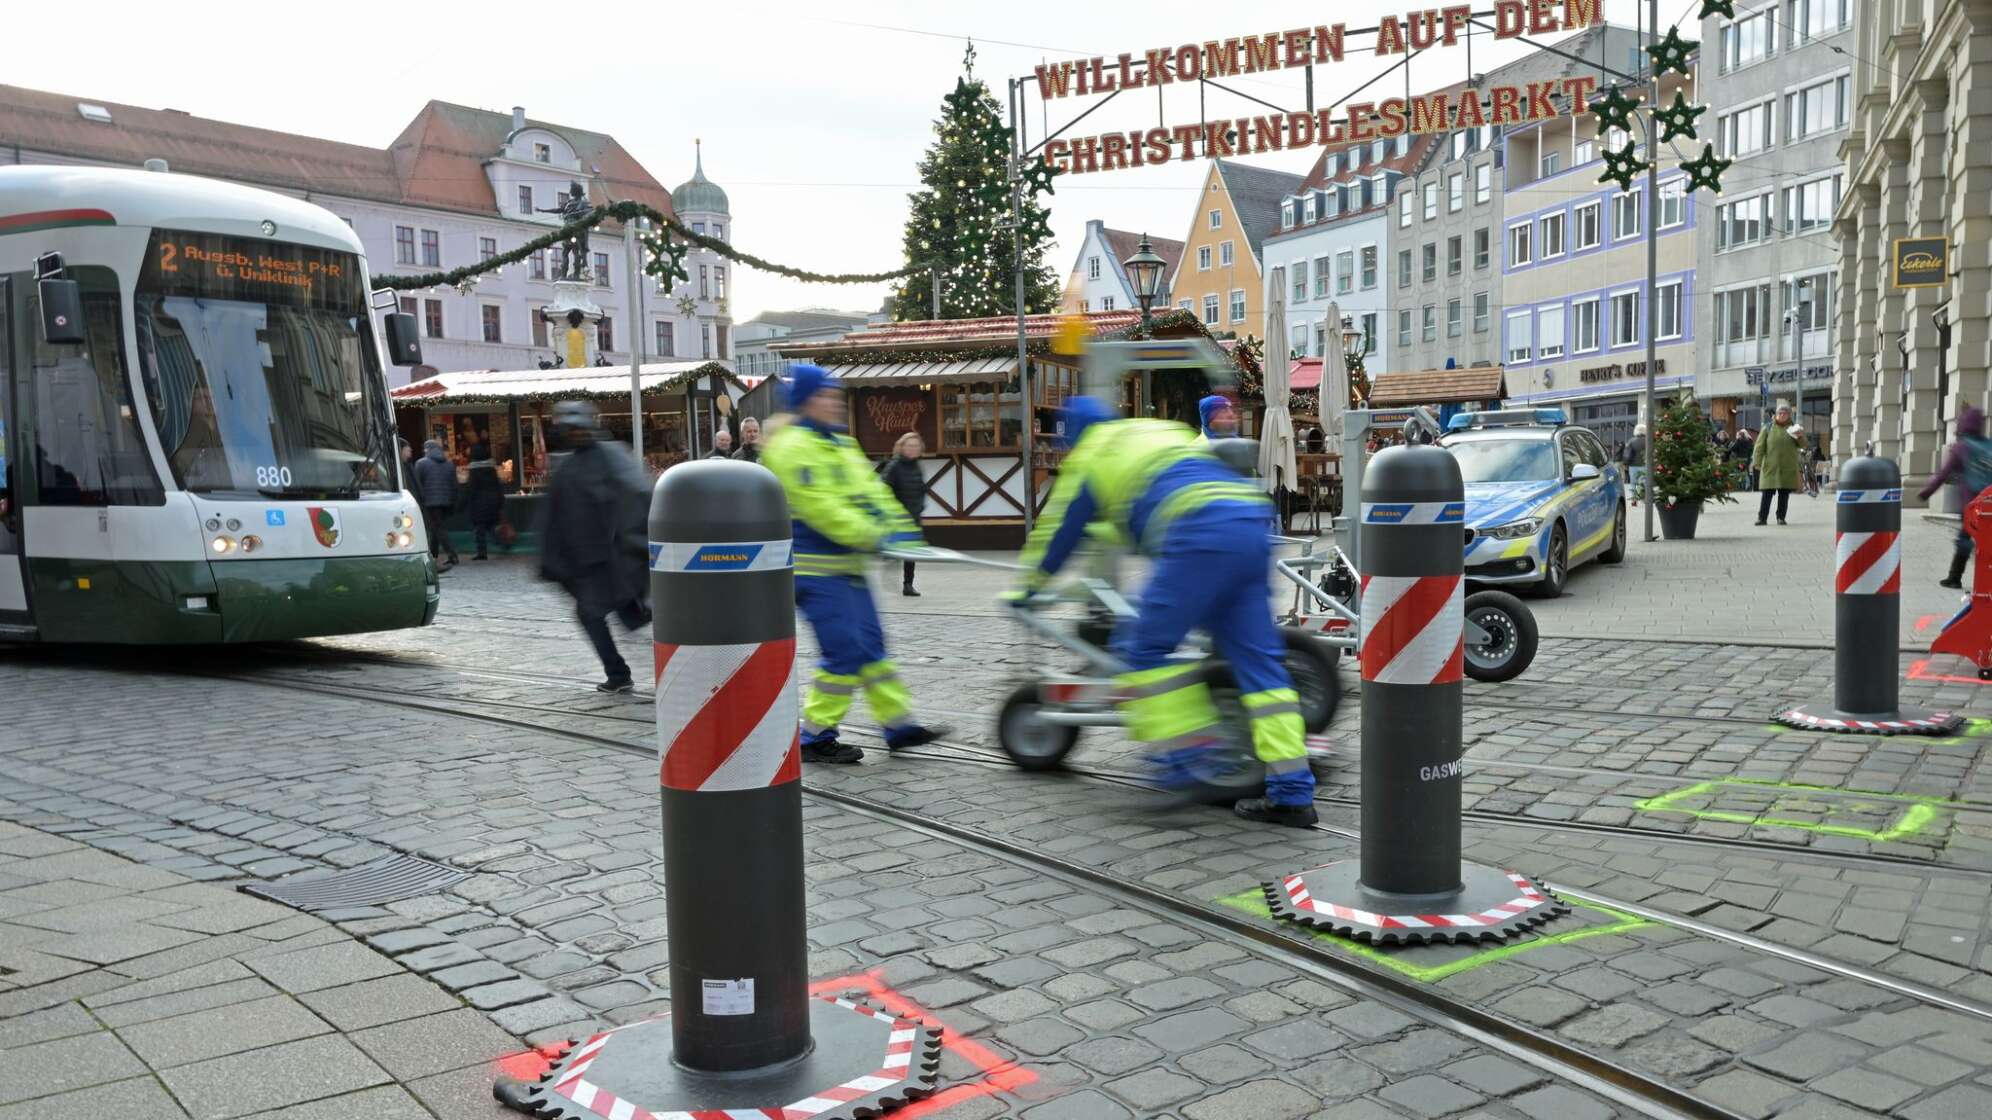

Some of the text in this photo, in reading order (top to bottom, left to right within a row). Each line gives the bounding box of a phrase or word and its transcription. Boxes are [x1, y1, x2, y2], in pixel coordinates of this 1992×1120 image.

[1035, 0, 1605, 101] WILLKOMMEN AUF DEM
[1044, 75, 1597, 176] CHRISTKINDLESMARKT
[159, 243, 178, 273] 2
[258, 255, 304, 273] West
[308, 261, 342, 280] P+R
[239, 266, 313, 288] Uniklinik
[256, 465, 292, 487] 880
